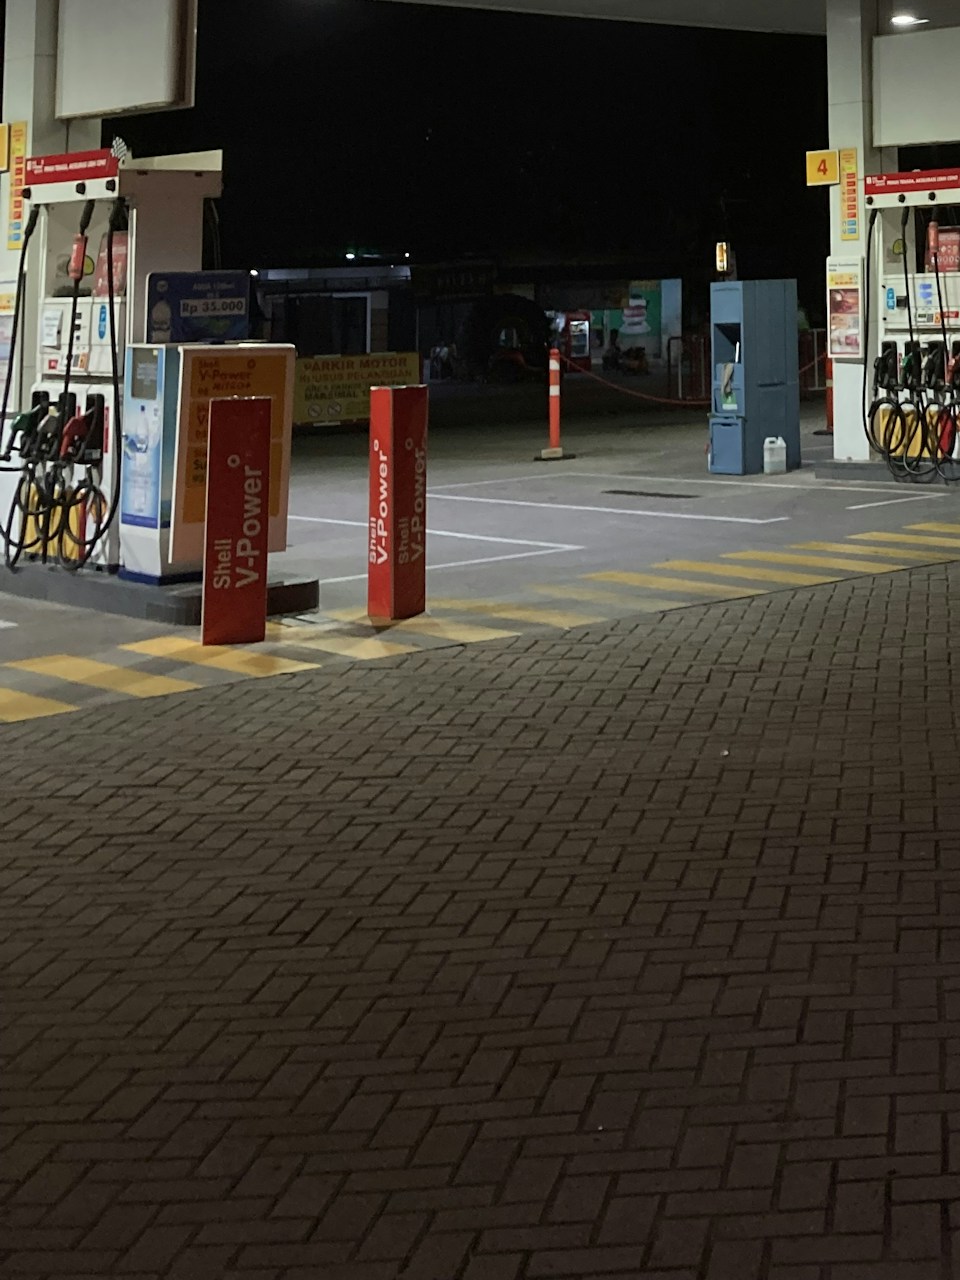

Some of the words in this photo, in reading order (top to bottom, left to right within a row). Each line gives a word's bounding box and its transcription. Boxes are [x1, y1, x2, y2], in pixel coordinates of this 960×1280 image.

[817, 158, 829, 175] 4
[182, 303, 198, 315] Rp
[202, 300, 244, 312] 35.000
[198, 369, 253, 381] V-Power
[303, 358, 356, 372] PARKIR
[359, 357, 408, 370] MOTOR
[377, 451, 388, 565] V-Power
[411, 447, 426, 562] V-Power
[235, 466, 262, 588] V-Power
[213, 538, 233, 589] Shell
